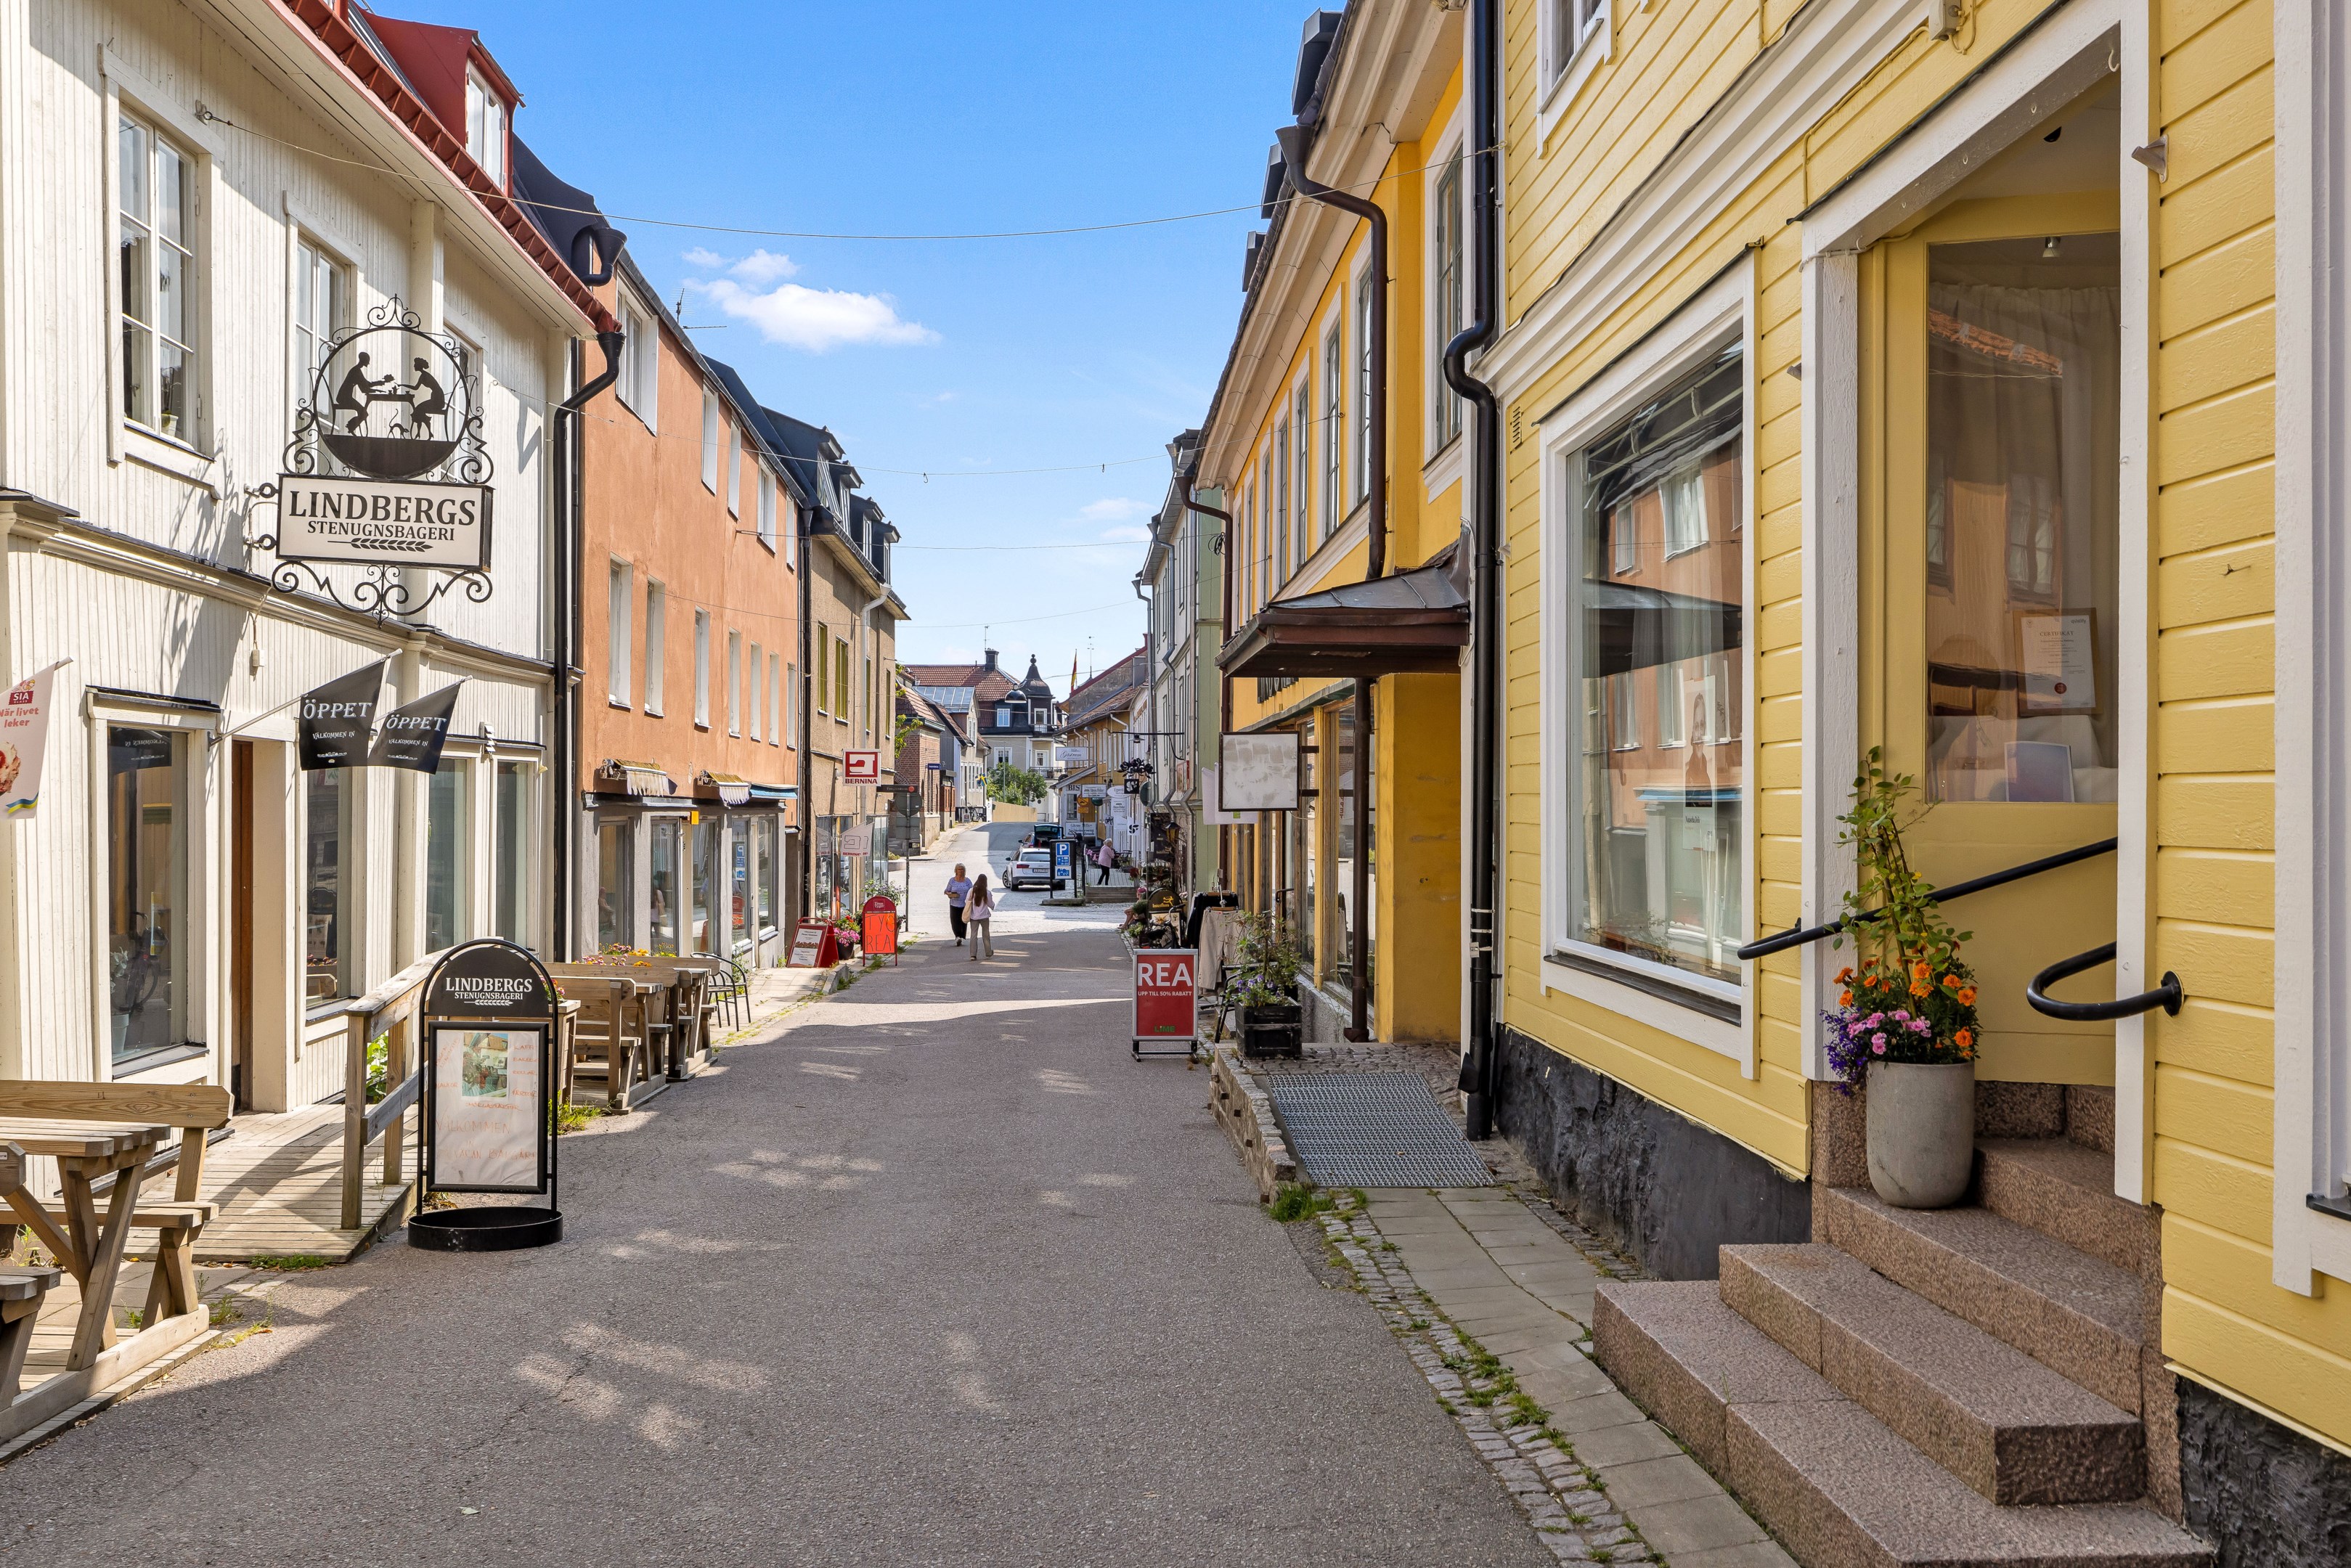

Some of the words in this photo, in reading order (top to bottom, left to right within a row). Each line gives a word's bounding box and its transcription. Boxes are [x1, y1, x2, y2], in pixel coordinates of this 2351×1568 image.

[290, 491, 476, 526] LINDBERGS
[307, 520, 455, 542] STENUGNSBAGERI
[13, 693, 29, 701] SIA
[16, 707, 39, 716] livet
[303, 699, 373, 720] ÖPPET
[4, 718, 30, 728] leker
[386, 714, 447, 732] ÖPPET
[312, 730, 347, 740] VÄLKOMMEN
[1059, 844, 1067, 855] P
[866, 934, 892, 952] REA
[1138, 963, 1193, 987] REA
[445, 977, 532, 993] LINDBERGS
[455, 992, 523, 1000] STENUGNSBAGERI
